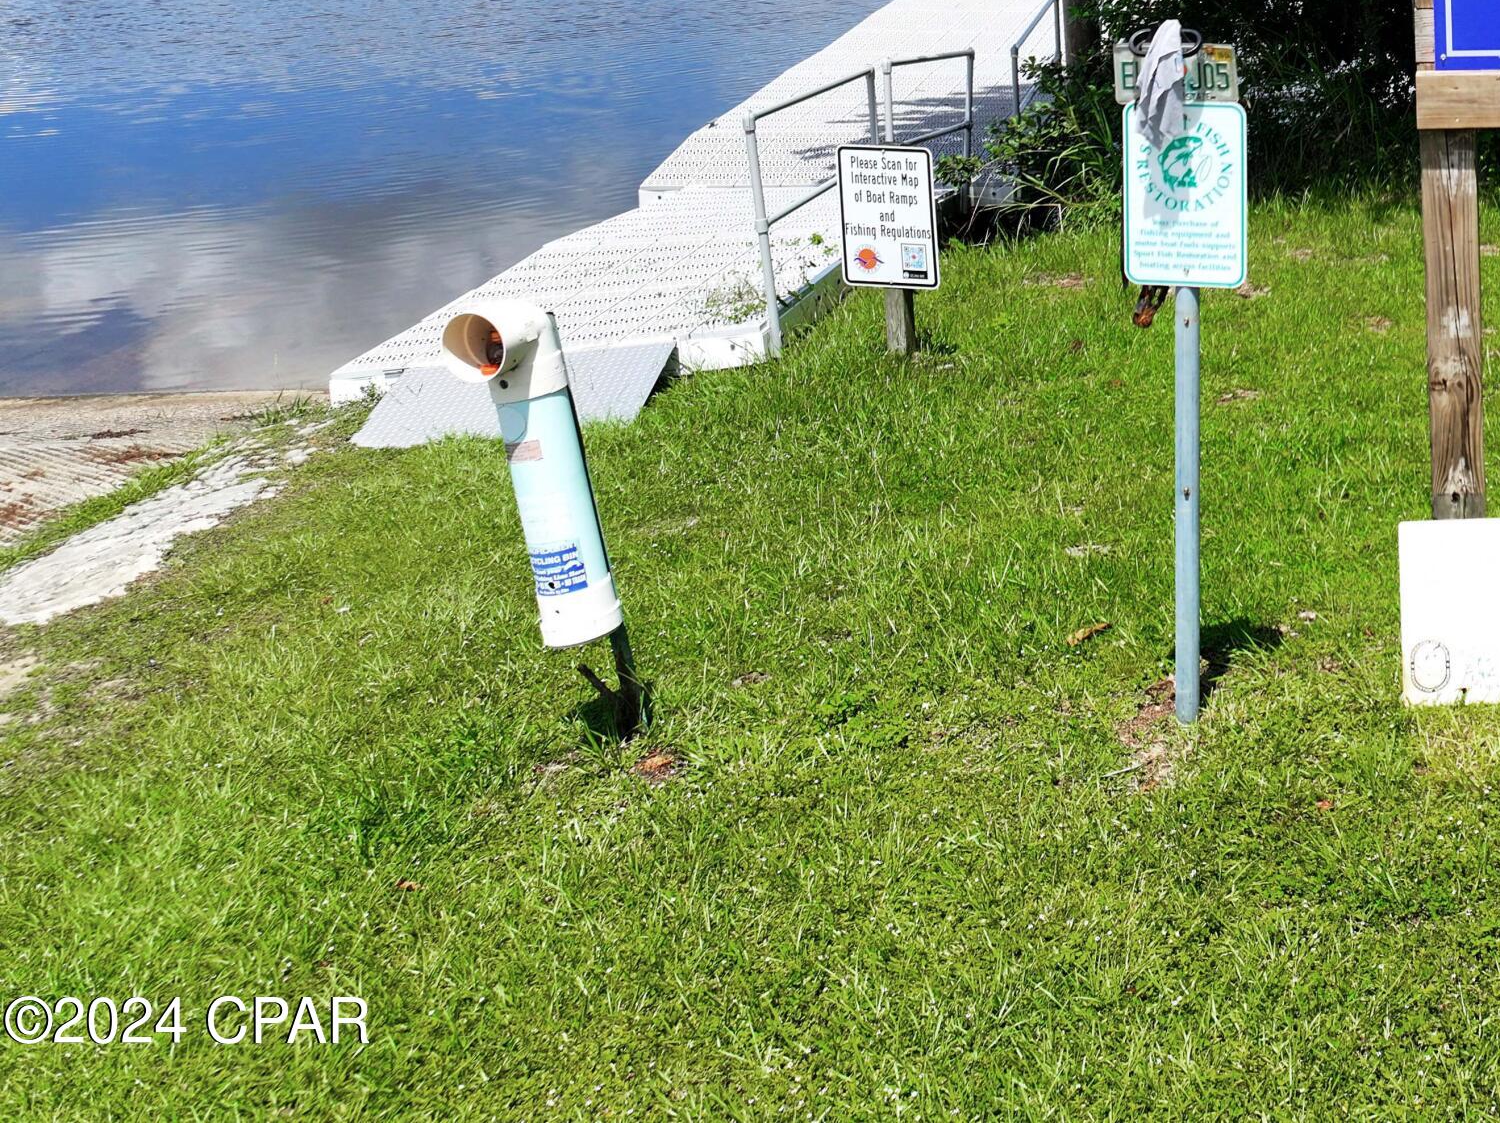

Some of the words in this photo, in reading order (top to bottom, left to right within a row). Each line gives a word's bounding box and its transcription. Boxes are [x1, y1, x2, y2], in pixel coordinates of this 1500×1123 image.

[1196, 122, 1230, 157] FISH
[850, 156, 878, 170] Please
[881, 157, 902, 170] Scan
[905, 158, 917, 171] for
[850, 171, 897, 185] Interactive
[901, 173, 919, 189] Map
[1137, 159, 1233, 211] RESTORATION
[854, 190, 863, 202] of
[866, 190, 886, 204] Boat
[889, 192, 918, 207] Ramps
[879, 209, 895, 223] and
[845, 223, 877, 240] Fishing
[880, 224, 932, 241] Regulations
